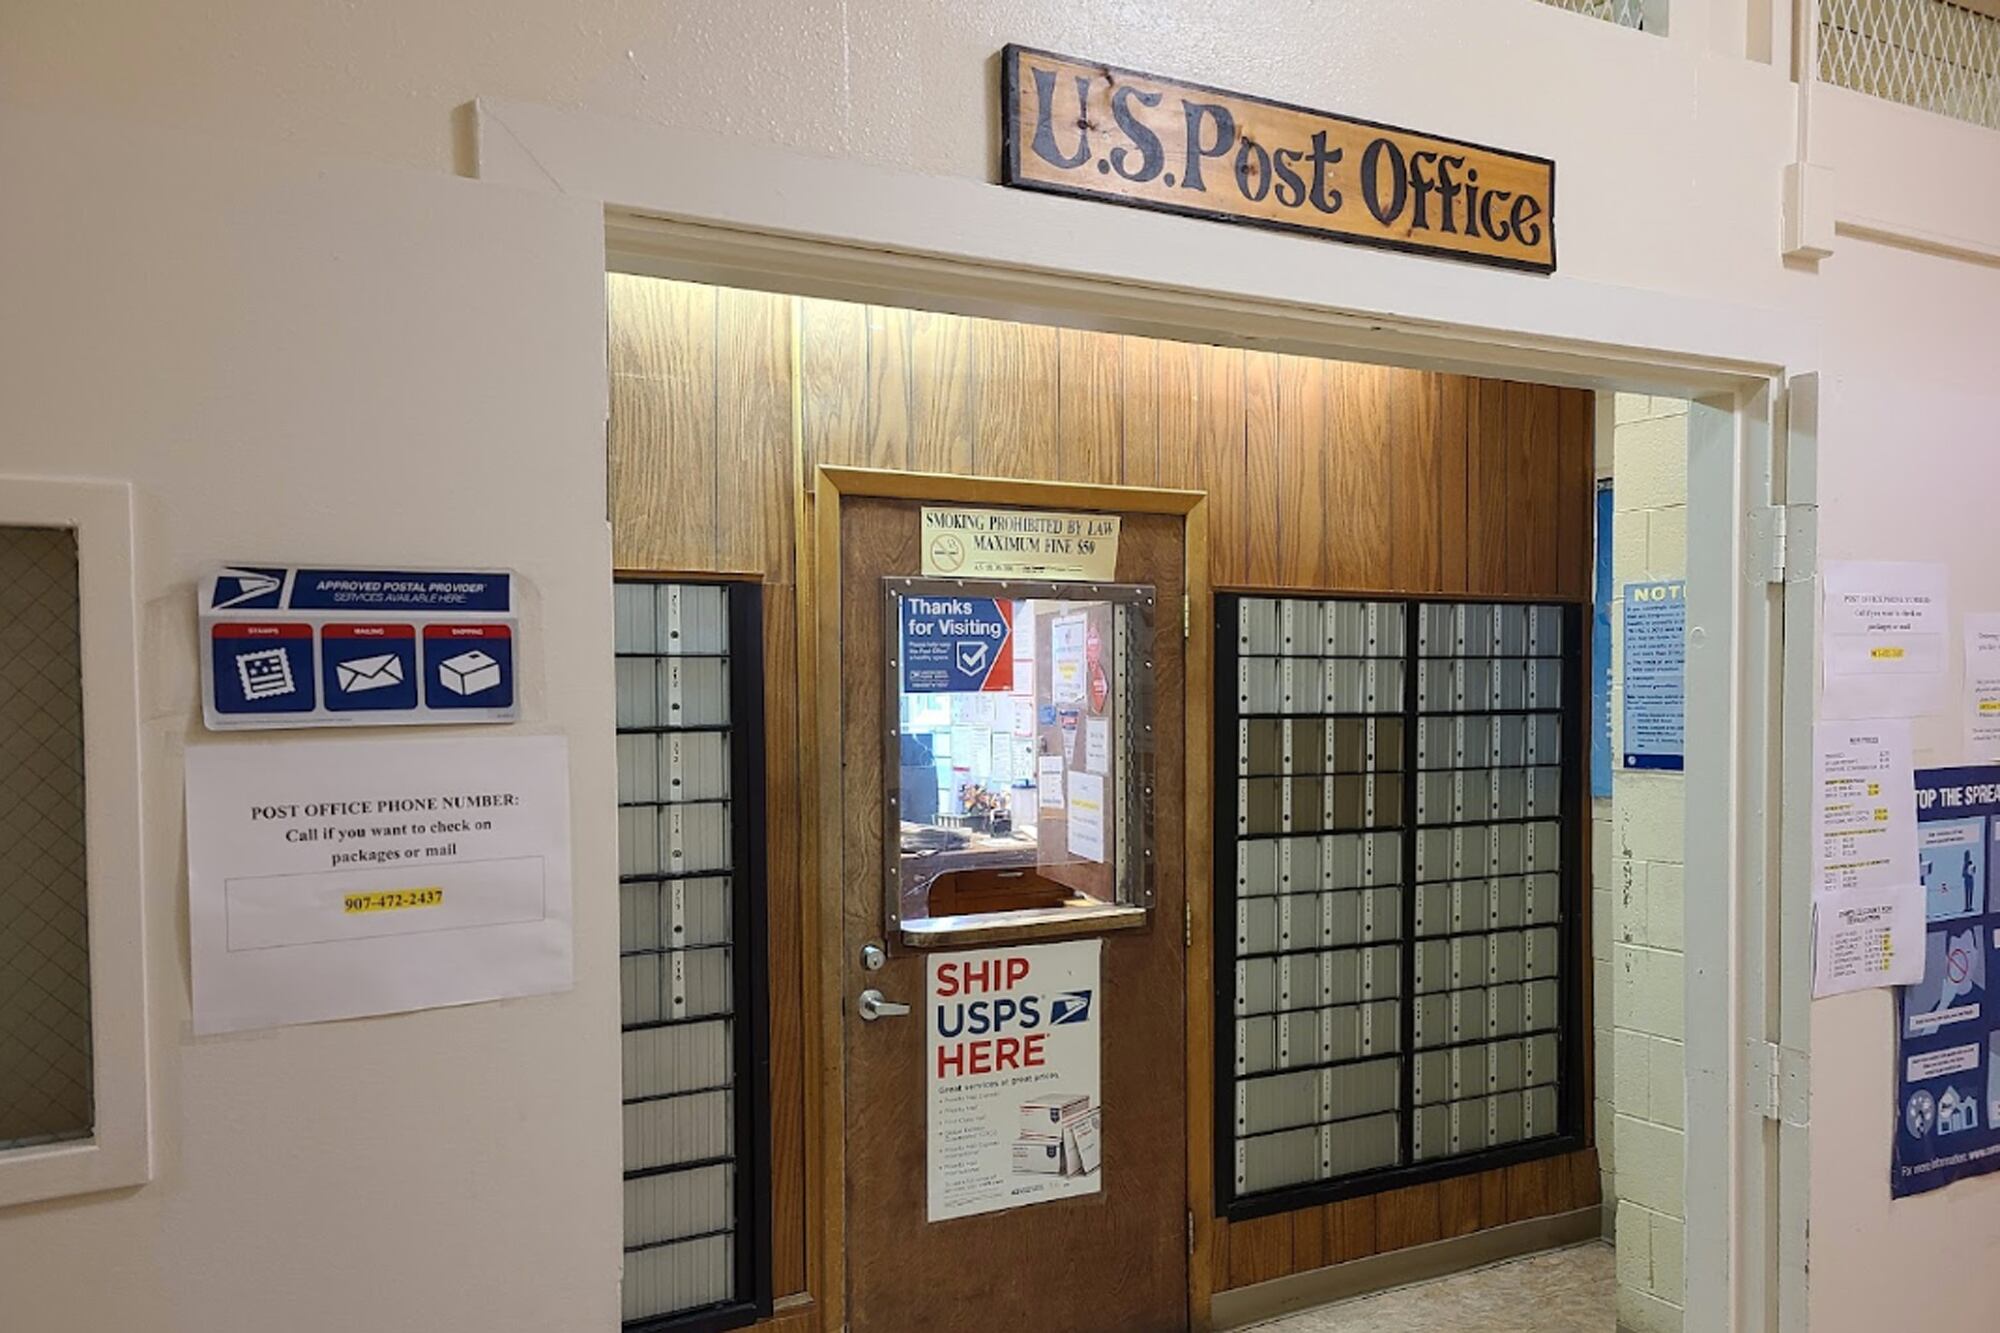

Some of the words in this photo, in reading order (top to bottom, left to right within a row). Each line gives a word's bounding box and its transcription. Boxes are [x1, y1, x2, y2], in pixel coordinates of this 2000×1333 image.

[1360, 138, 1542, 246] Office
[926, 513, 984, 531] SMOKING
[990, 516, 1061, 534] PROHIBITED
[1067, 522, 1081, 535] BY
[1088, 521, 1114, 536] LAW
[974, 535, 1040, 552] MAXIMUM
[1045, 538, 1073, 554] FINE
[316, 580, 381, 591] APPROVED
[383, 582, 427, 592] POSTAL
[385, 592, 437, 603] AVAILABLE
[908, 598, 972, 615] Thanks
[908, 619, 934, 635] for
[938, 619, 1001, 638] Visiting
[251, 804, 299, 820] POST
[304, 801, 372, 817] OFFICE
[378, 797, 438, 813] PHONE
[442, 793, 519, 810] NUMBER:
[1939, 787, 1963, 807] THE
[285, 828, 318, 843] Call
[323, 826, 336, 840] if
[338, 828, 366, 843] you
[371, 824, 407, 837] want
[412, 822, 426, 834] to
[430, 819, 470, 833] check
[475, 820, 492, 831] on
[332, 849, 400, 867] packages
[404, 848, 420, 858] or
[425, 843, 457, 857] mail
[344, 890, 443, 911] 907-472-2437
[936, 957, 1030, 997] SHIP
[937, 996, 1041, 1038] USPS
[938, 1033, 1046, 1078] HERE
[965, 1081, 999, 1091] services
[1012, 1075, 1033, 1085] great
